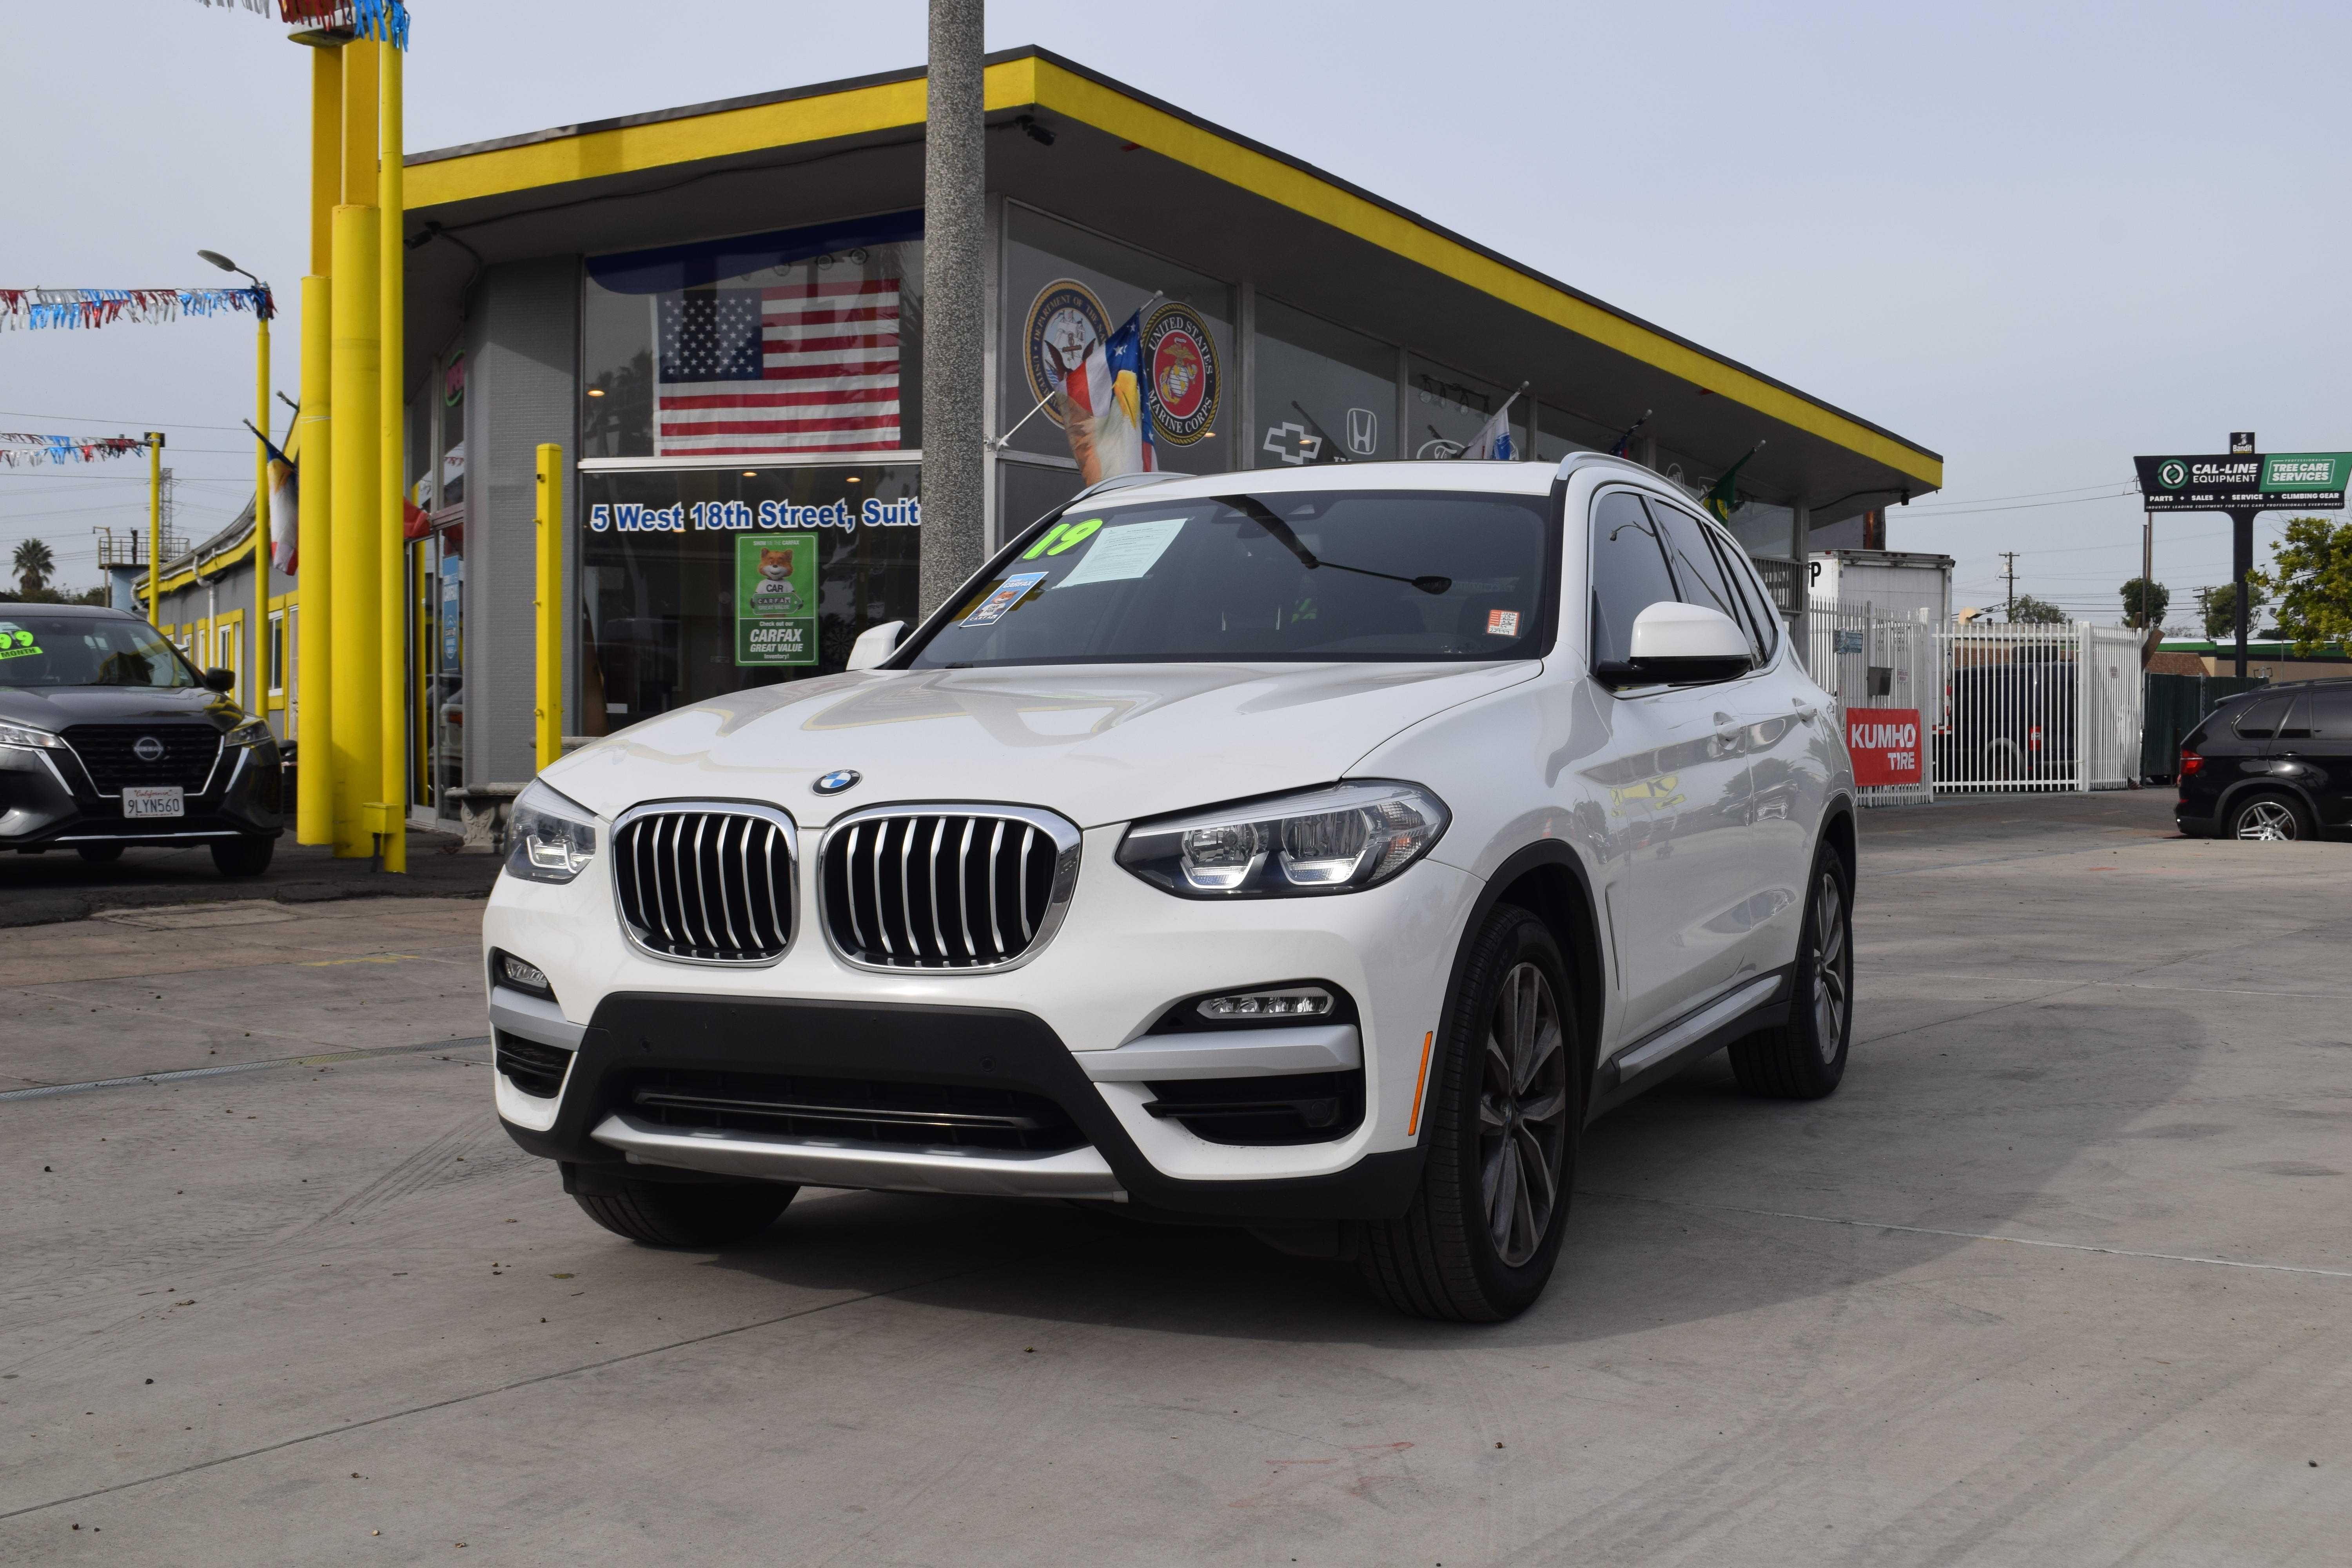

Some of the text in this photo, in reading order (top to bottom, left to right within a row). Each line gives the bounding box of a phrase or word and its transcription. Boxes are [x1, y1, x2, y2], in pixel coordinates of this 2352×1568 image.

[1034, 295, 1071, 341] DEPARTMENT
[1073, 297, 1083, 307] OF
[1149, 317, 1213, 374] UNITED STATES
[1148, 388, 1213, 433] MARINE CORPS
[2192, 463, 2258, 474] CAL-LINE
[2273, 463, 2330, 472] TREE CARE
[2193, 474, 2257, 483] EQUIPMENT
[2272, 472, 2329, 481] SERVICES
[613, 501, 685, 532] West
[690, 500, 753, 530] 18th
[758, 497, 856, 534] Street,
[862, 495, 921, 527] Suit
[1022, 519, 1103, 560] 19
[766, 584, 784, 592] CAR
[1002, 580, 1034, 588] CARFAX
[750, 628, 804, 642] CARFAX
[1, 648, 36, 658] MONTH
[750, 643, 804, 652] GREAT VALUE
[1851, 724, 1916, 749] KUMHO
[1887, 751, 1915, 770] TIRE
[128, 798, 180, 813] 9LYN560
